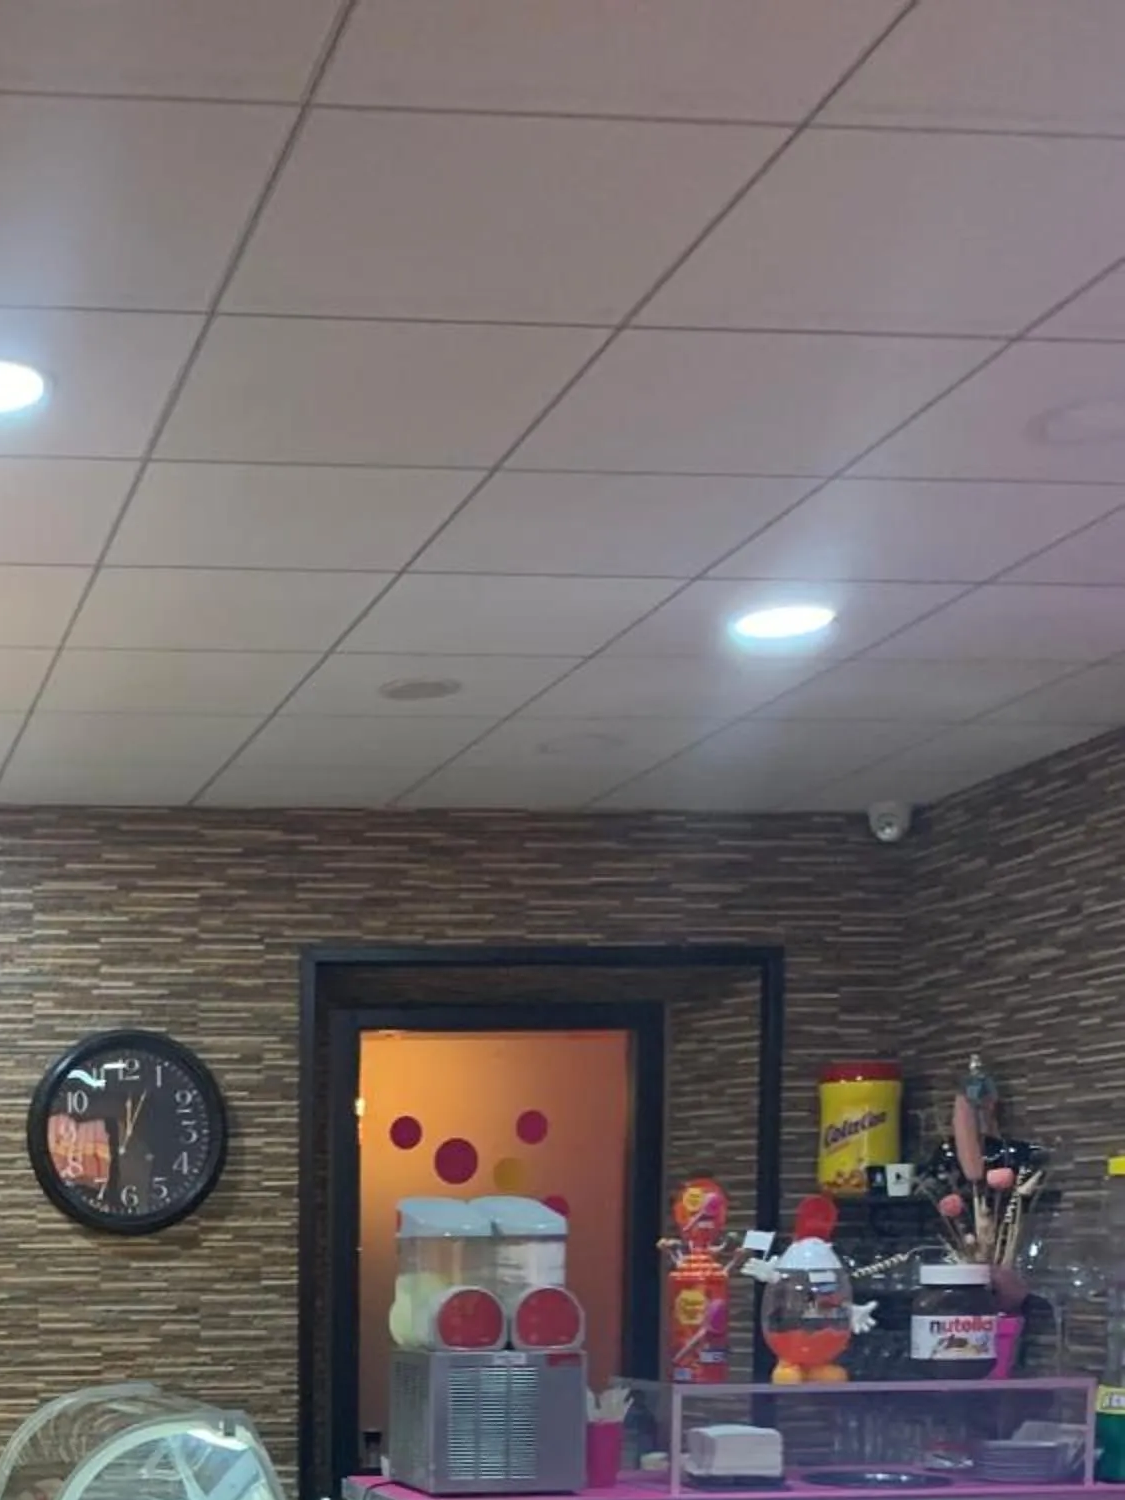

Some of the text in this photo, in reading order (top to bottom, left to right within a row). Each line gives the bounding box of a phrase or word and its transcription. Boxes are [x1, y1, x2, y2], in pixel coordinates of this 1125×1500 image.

[118, 1058, 140, 1081] 12
[155, 1065, 163, 1088] 1
[67, 1090, 88, 1114] 10
[175, 1090, 193, 1113] 2
[181, 1120, 198, 1144] 3
[65, 1156, 84, 1178] 8
[172, 1152, 189, 1175] 4
[94, 1178, 109, 1200] 7
[120, 1185, 139, 1207] 6
[152, 1177, 169, 1199] 5
